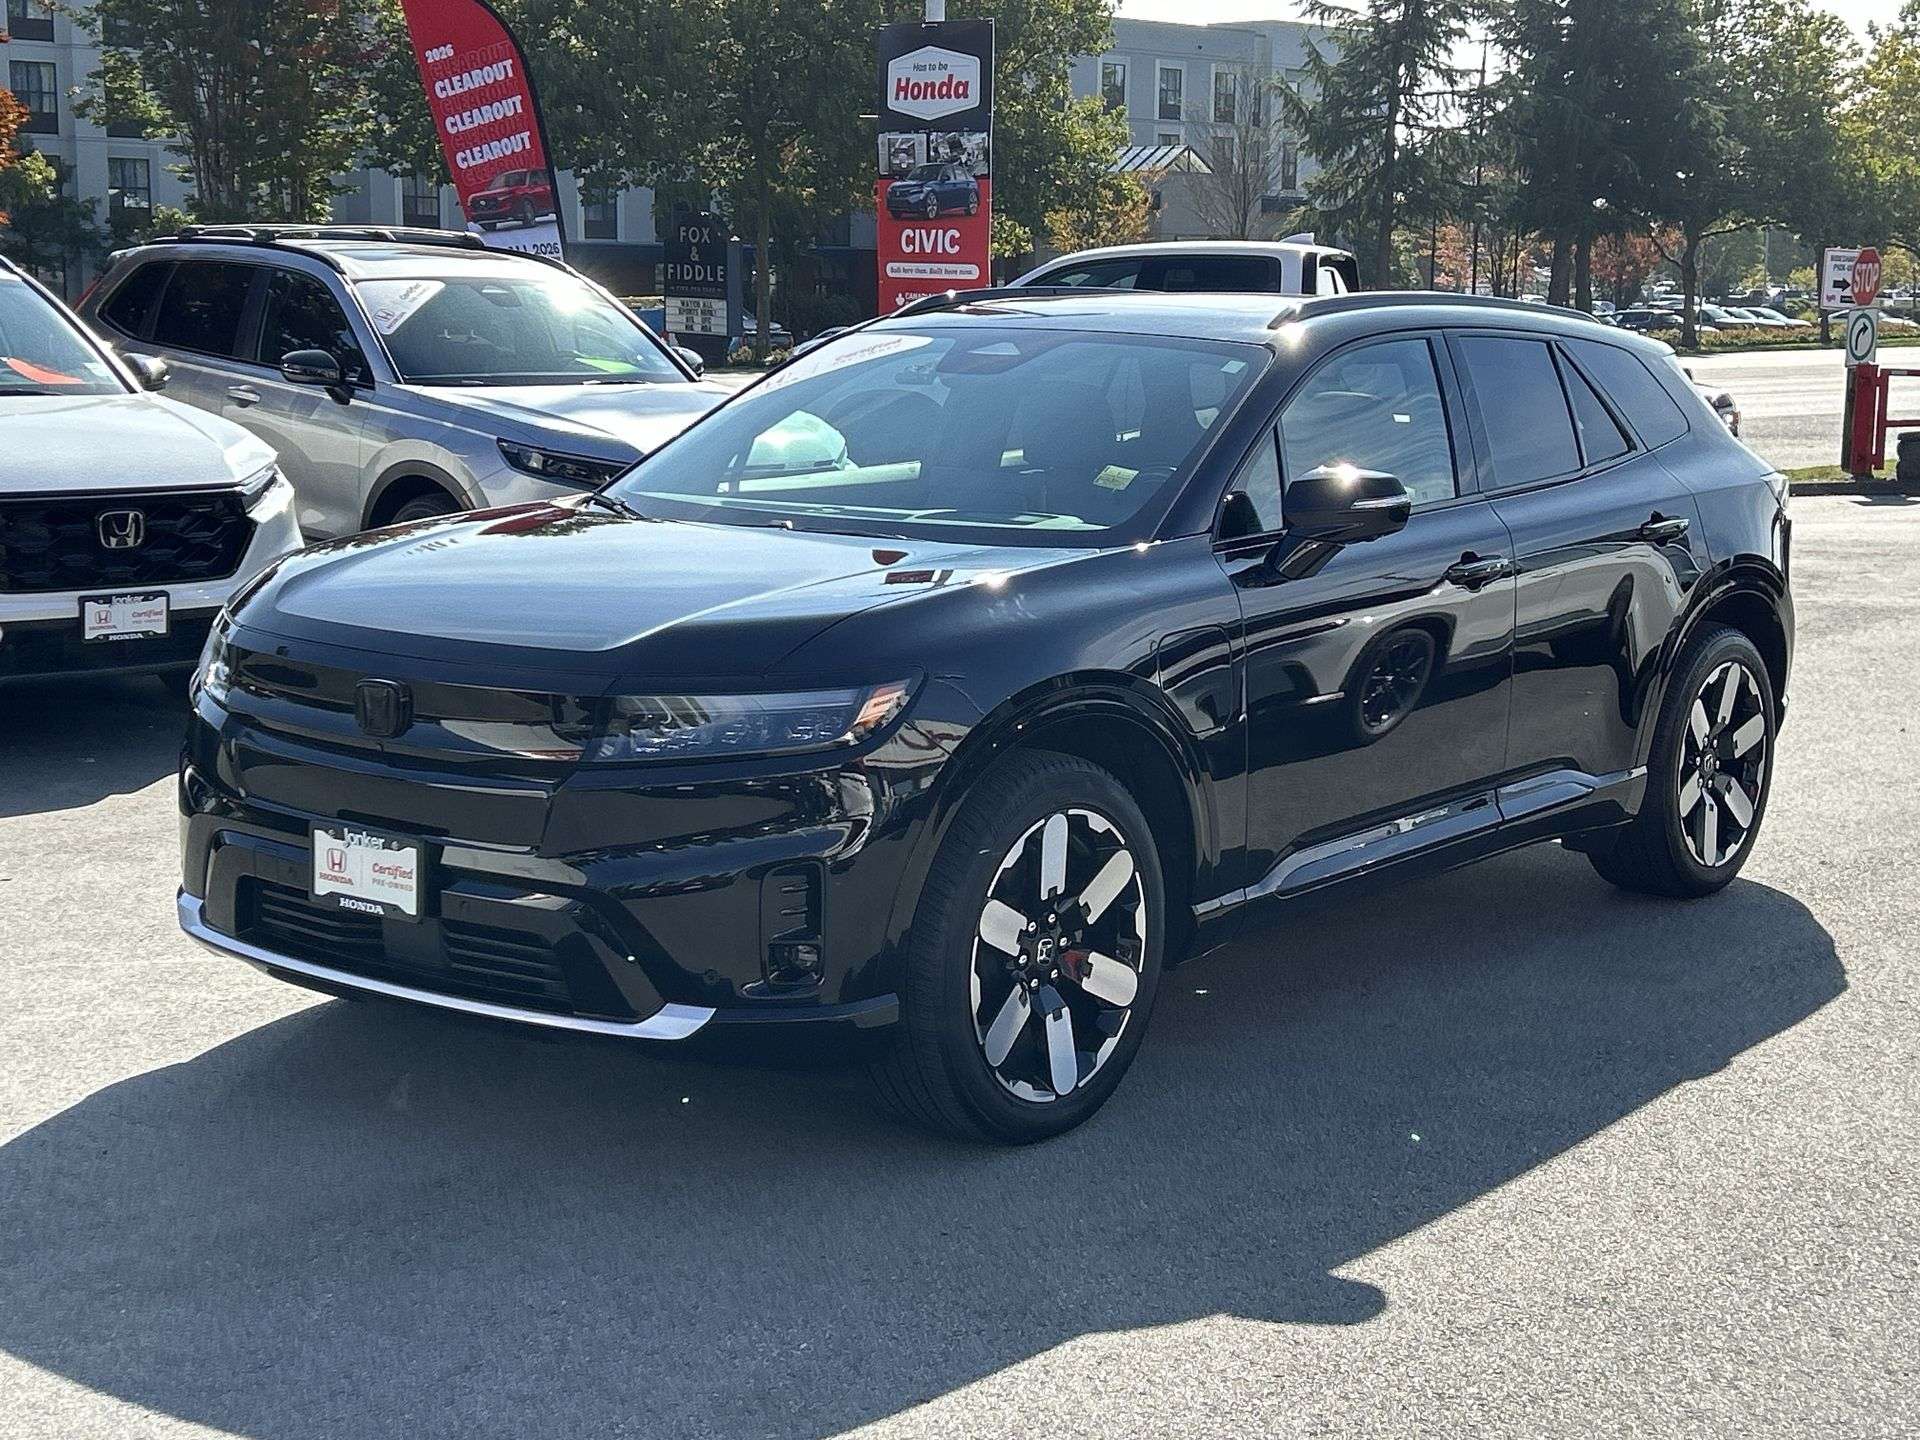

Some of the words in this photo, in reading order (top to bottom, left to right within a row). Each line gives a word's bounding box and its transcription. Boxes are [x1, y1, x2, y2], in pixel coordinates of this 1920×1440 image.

[425, 44, 455, 63] 2026
[928, 63, 936, 71] to
[938, 61, 948, 71] be
[435, 59, 513, 99] CLEAROUT
[894, 73, 969, 101] Honda
[445, 95, 523, 134] CLEAROUT
[455, 131, 531, 170] CLEAROUT
[680, 226, 711, 243] FOX
[901, 228, 960, 254] CIVIC
[532, 242, 560, 255] 2026
[690, 246, 699, 261] &
[667, 264, 724, 281] FIDDLE
[1854, 262, 1880, 293] STOP
[108, 633, 144, 641] HONDA
[319, 872, 354, 885] HONDA
[372, 862, 414, 879] Certified
[339, 897, 385, 915] HONDA
